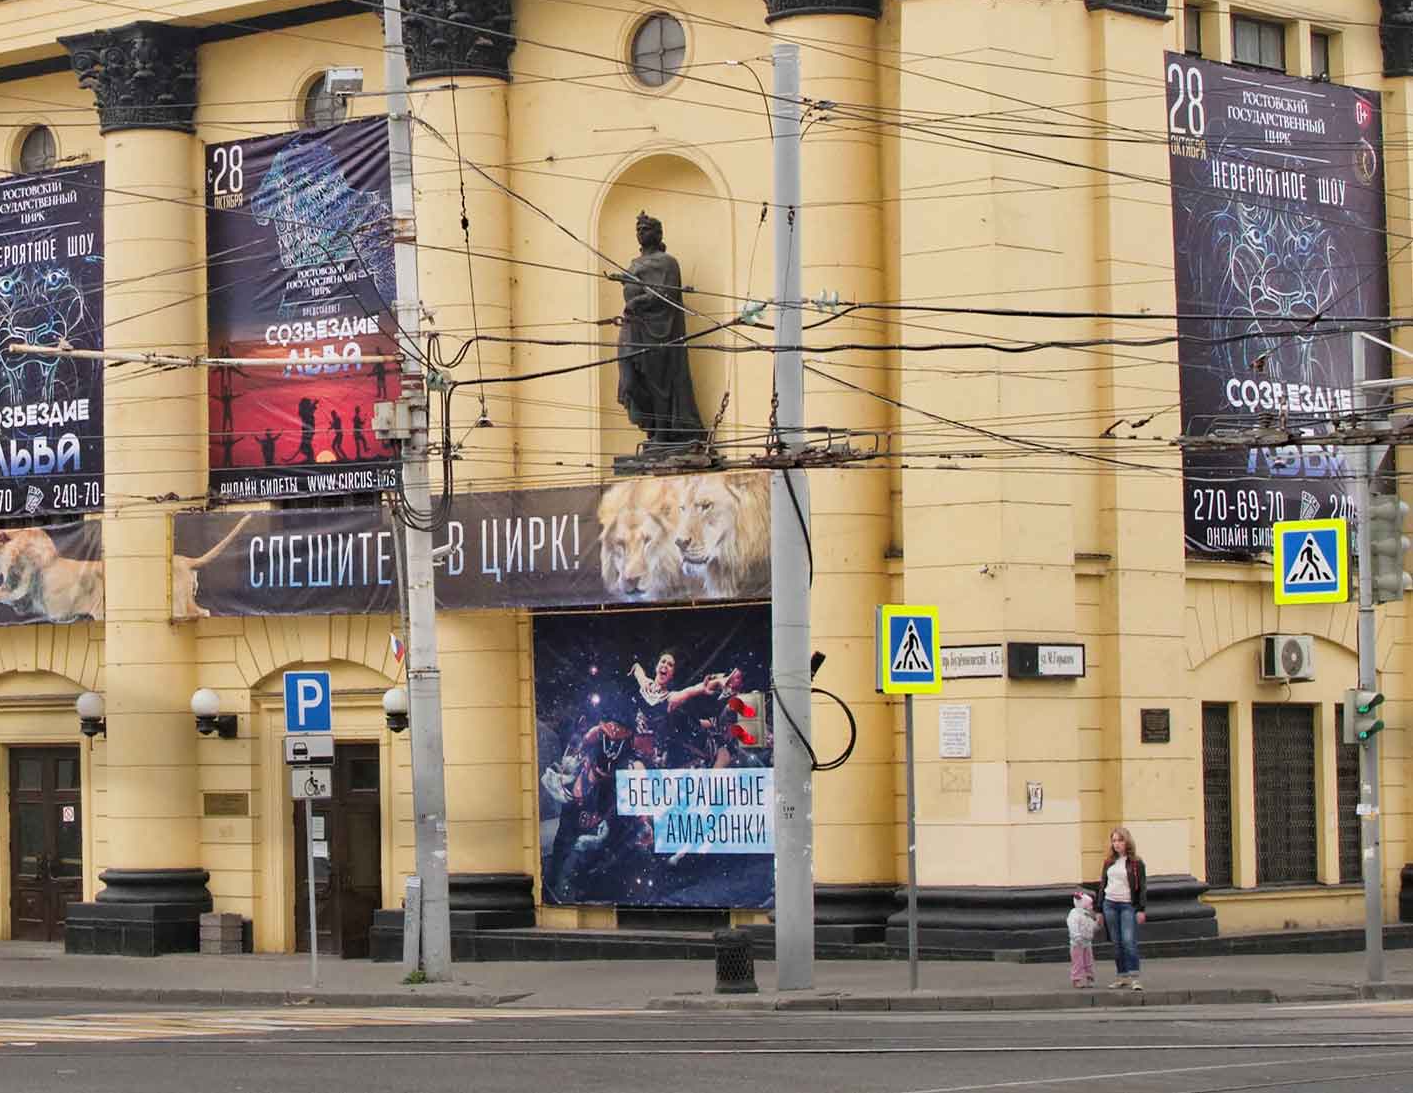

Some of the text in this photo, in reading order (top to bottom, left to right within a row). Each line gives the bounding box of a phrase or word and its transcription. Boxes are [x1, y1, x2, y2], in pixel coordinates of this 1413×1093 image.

[1167, 63, 1205, 137] 28
[1242, 91, 1308, 114] РОСТОВСКИЙ
[1227, 106, 1325, 134] ГОСУДАРСТВЕННЫЙ
[1265, 130, 1291, 146] ЦИРК
[213, 145, 243, 195] 28
[1212, 160, 1346, 206] НЕВЕРОЯТНОЕ ШОУ
[2, 181, 62, 201] РОСТОВСКИЙ
[214, 193, 243, 210] ОКТЯБРЯ
[21, 211, 45, 224] ЦИРК
[67, 233, 94, 258] ШОУ
[265, 315, 380, 346] СОЗВЕЗДИЕ
[283, 342, 362, 379] ЛЬВА
[1227, 378, 1353, 419] СОЗВЕЗДИЕ
[220, 478, 257, 495] ОНЛАЙН
[260, 477, 298, 495] БИЛЕТЫ
[1194, 489, 1284, 521] 270-69-70
[1207, 524, 1248, 546] ОНЛАЙН
[249, 514, 580, 590] СПЕШИТЕ В ЦИРК!
[297, 679, 323, 725] P
[628, 775, 765, 807] БЕССТРАШНЫЕ
[666, 813, 766, 844] АМАЗОНКИ
